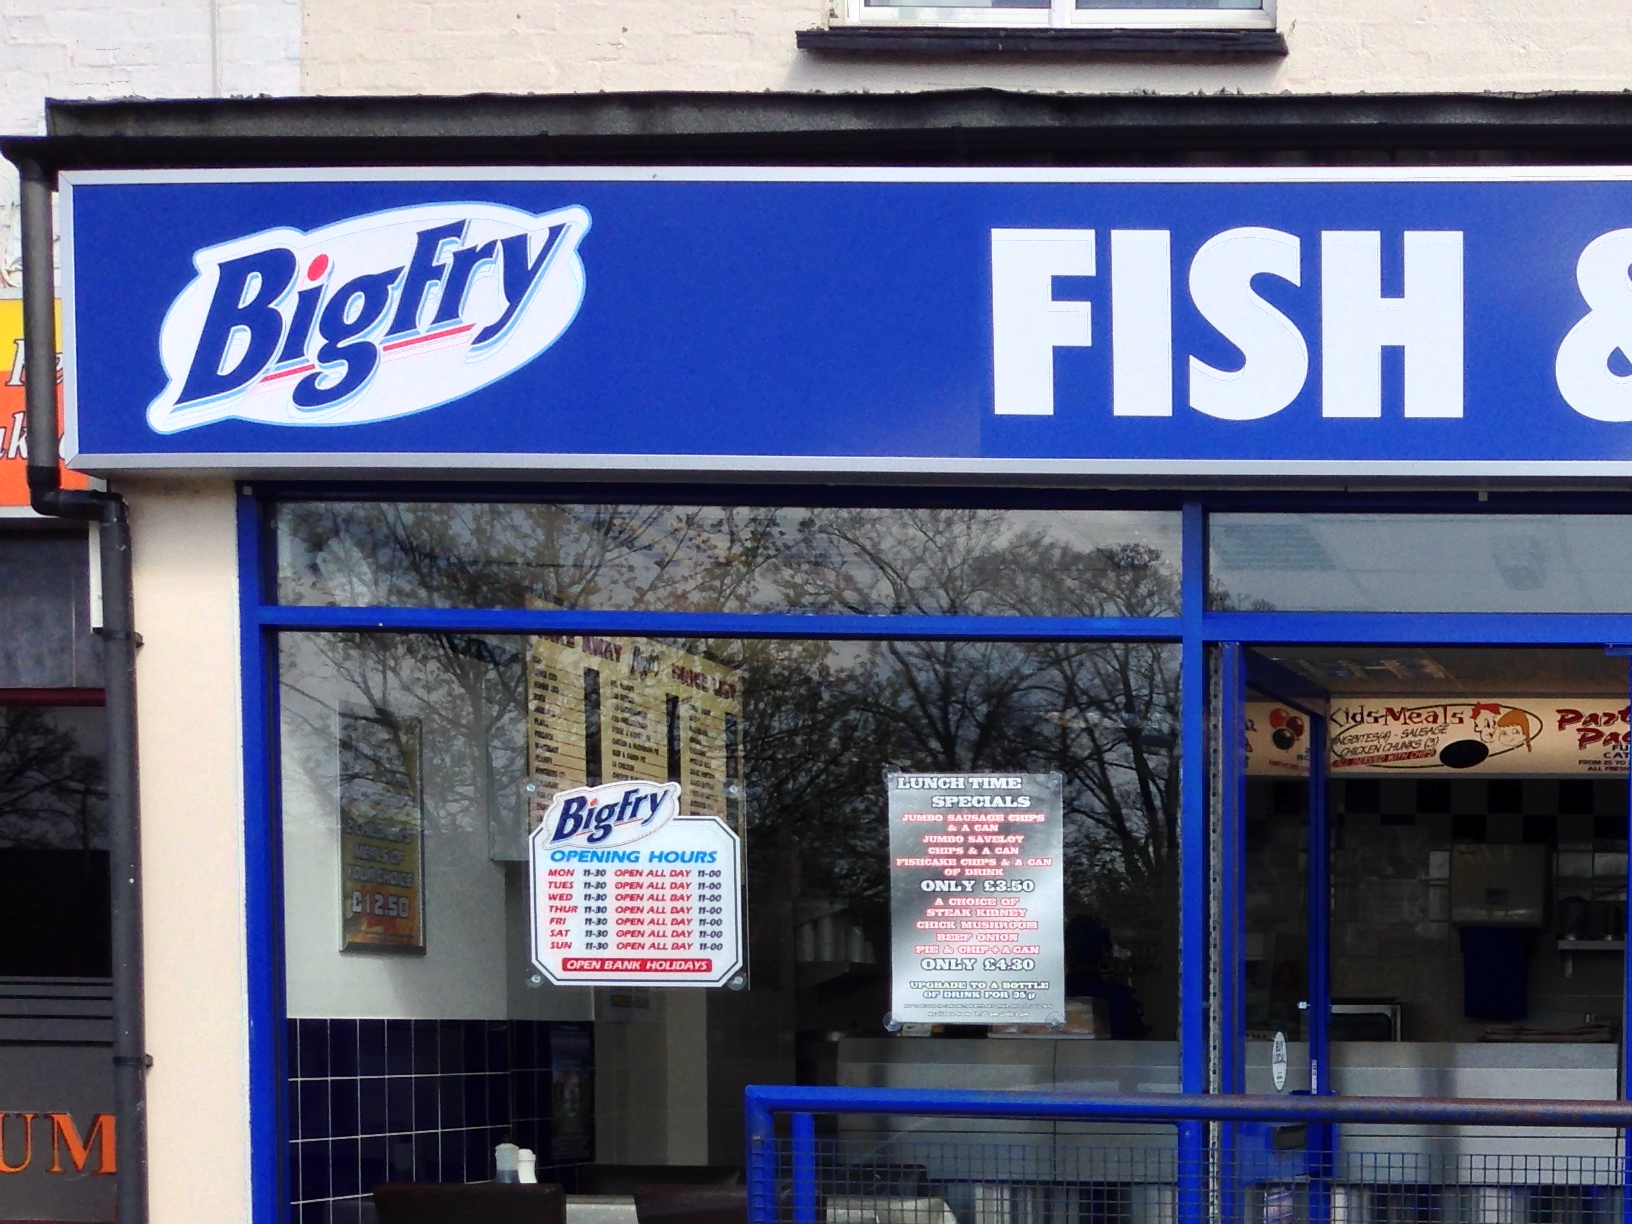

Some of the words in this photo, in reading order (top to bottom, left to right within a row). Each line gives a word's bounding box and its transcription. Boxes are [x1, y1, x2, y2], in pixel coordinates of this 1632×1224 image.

[172, 216, 567, 410] BigFry
[991, 226, 1464, 421] FISH
[1382, 704, 1464, 726] Meals
[1555, 705, 1630, 731] Part
[897, 777, 965, 790] LUNCH
[968, 777, 1022, 790] TIME
[932, 795, 1031, 808] SPECIALS
[550, 788, 668, 844] BigFry
[901, 814, 943, 822] JUMBO
[948, 814, 1004, 822] SAUSAGE
[1008, 814, 1045, 822] CHIPS
[974, 824, 999, 832] CAN
[922, 835, 964, 843] JUMBO
[968, 835, 1024, 843] SAVELOY
[928, 847, 963, 855] CHIPS
[995, 847, 1019, 855] CAN
[550, 850, 640, 863] OPENING
[648, 850, 718, 864] HOURS
[896, 858, 956, 866] FISHCAKE
[961, 858, 997, 866] CHIPS
[1027, 858, 1052, 866] CAN
[548, 869, 575, 877] MON
[583, 869, 606, 877] 11-30
[614, 869, 644, 877] OPEN
[646, 869, 667, 877] ALL
[670, 869, 691, 877] DAY
[697, 869, 721, 878] 11-00
[548, 881, 574, 889] TUES
[583, 881, 607, 890] 11-30
[615, 881, 644, 890] OPEN
[647, 881, 667, 890] ALL
[670, 881, 692, 890] DAY
[698, 882, 721, 890] 11-00
[921, 880, 975, 892] ONLY
[983, 880, 1034, 892] £3.50
[548, 893, 573, 901] WED
[584, 893, 607, 902] 11-30
[615, 893, 644, 902] OPEN
[647, 893, 668, 902] ALL
[670, 893, 692, 902] DAY
[698, 894, 722, 902] 11-00
[949, 898, 997, 906] CHOICE
[549, 906, 578, 914] THUR
[584, 906, 607, 914] 11-30
[615, 906, 644, 914] OPEN
[647, 906, 668, 914] ALL
[671, 906, 692, 914] DAY
[698, 906, 722, 914] 11-00
[927, 909, 972, 917] STEAK
[976, 909, 1027, 917] KIDNEY
[550, 918, 566, 926] FRI
[584, 918, 608, 926] 11-30
[616, 918, 645, 926] OPEN
[648, 918, 668, 926] ALL
[671, 918, 693, 926] DAY
[699, 918, 722, 926] 11-00
[917, 921, 955, 929] CHICK
[550, 930, 570, 938] SAT
[585, 930, 608, 938] 11-30
[616, 930, 645, 938] OPEN
[648, 930, 669, 938] ALL
[671, 930, 693, 938] DAY
[699, 930, 723, 938] 11-00
[550, 942, 572, 950] SUN
[585, 942, 608, 950] 11-30
[616, 942, 645, 950] OPEN
[648, 942, 669, 950] ALL
[672, 942, 693, 950] DAY
[699, 942, 723, 951] 11-00
[1013, 946, 1040, 954] CAN
[566, 960, 601, 970] OPEN
[604, 961, 640, 970] BANK
[645, 961, 707, 971] HOLIDAYS
[921, 958, 976, 971] ONLY
[983, 958, 1035, 971] £4.30
[910, 982, 967, 990] UPGRADE
[970, 982, 986, 990] TO
[1003, 982, 1049, 990] BOTTLE
[943, 991, 981, 999] DRINK
[984, 991, 1009, 999] FOR
